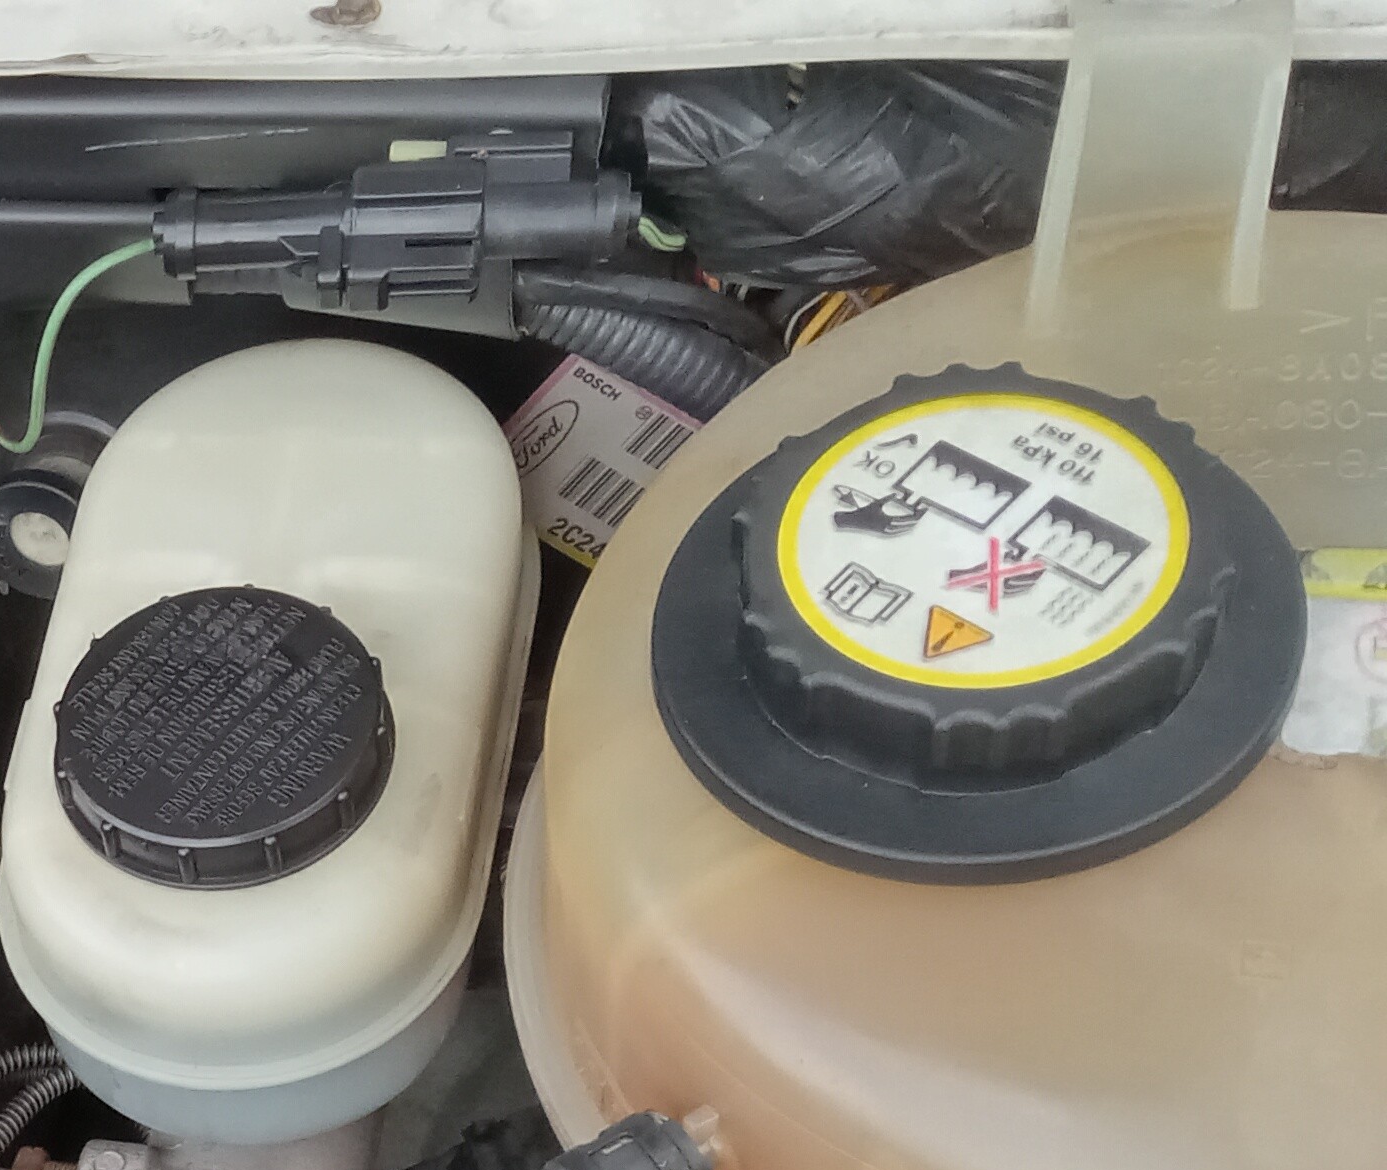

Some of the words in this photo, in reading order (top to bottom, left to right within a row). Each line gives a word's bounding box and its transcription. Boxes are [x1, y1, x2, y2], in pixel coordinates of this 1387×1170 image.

[573, 366, 623, 401] BOSCH
[515, 416, 564, 470] Ford
[1034, 422, 1076, 445] psi
[853, 450, 897, 479] OK
[1012, 435, 1058, 471] kPa
[1074, 441, 1105, 464] 16
[1058, 457, 1097, 486] 110
[546, 517, 607, 560] 2C24
[154, 749, 229, 823] CONTAINER
[266, 730, 351, 808] WARNING
